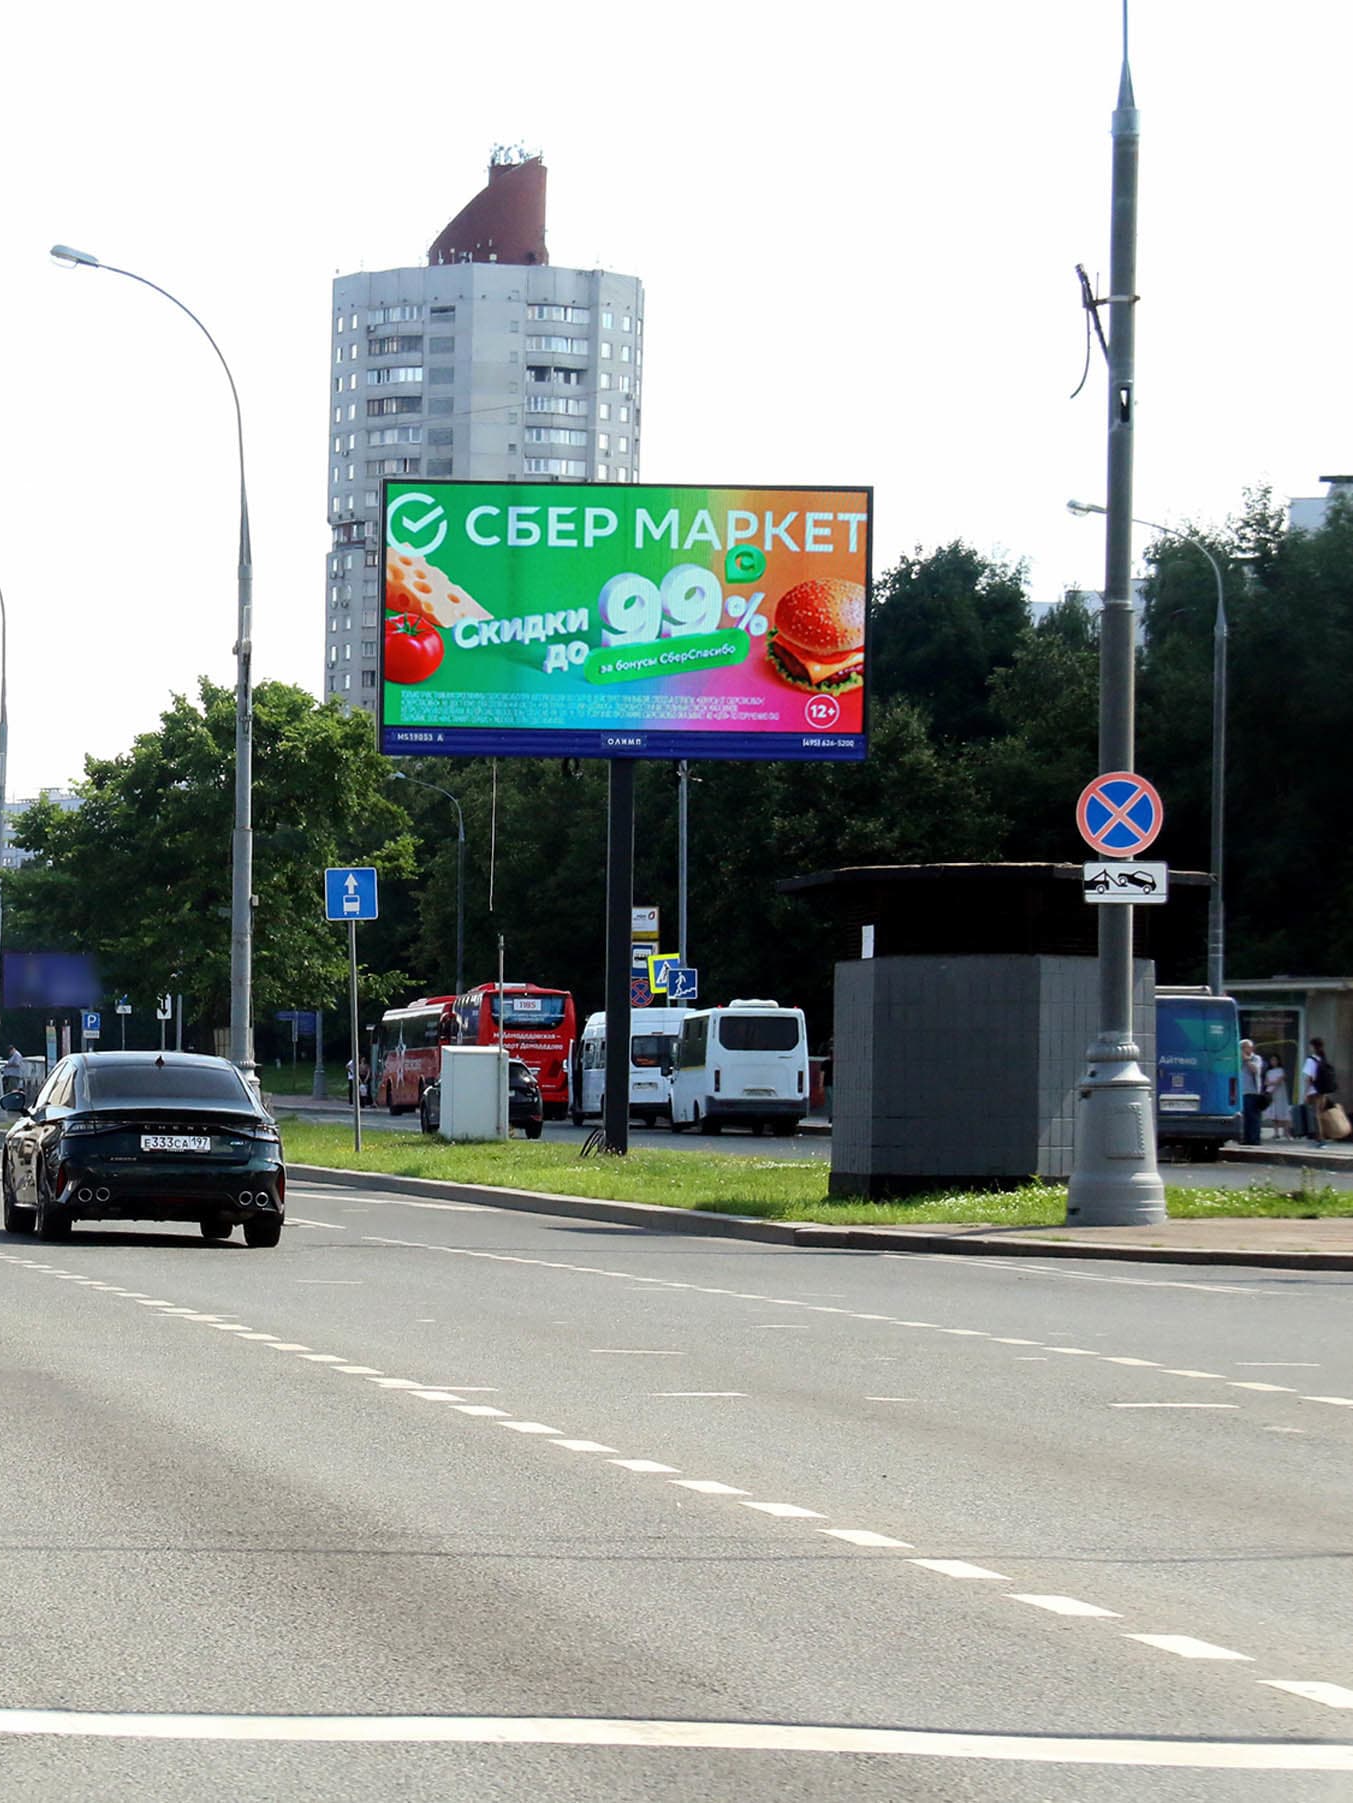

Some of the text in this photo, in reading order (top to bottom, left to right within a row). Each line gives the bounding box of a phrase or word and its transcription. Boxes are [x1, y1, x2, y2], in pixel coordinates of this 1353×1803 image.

[465, 505, 867, 552] СБЕР МАРКЕТ
[453, 607, 588, 648] Скидки
[543, 640, 589, 674] до
[601, 643, 736, 674] за бонусы СберСпасибо
[810, 705, 836, 718] 12+
[607, 738, 641, 746] ОЛИМП
